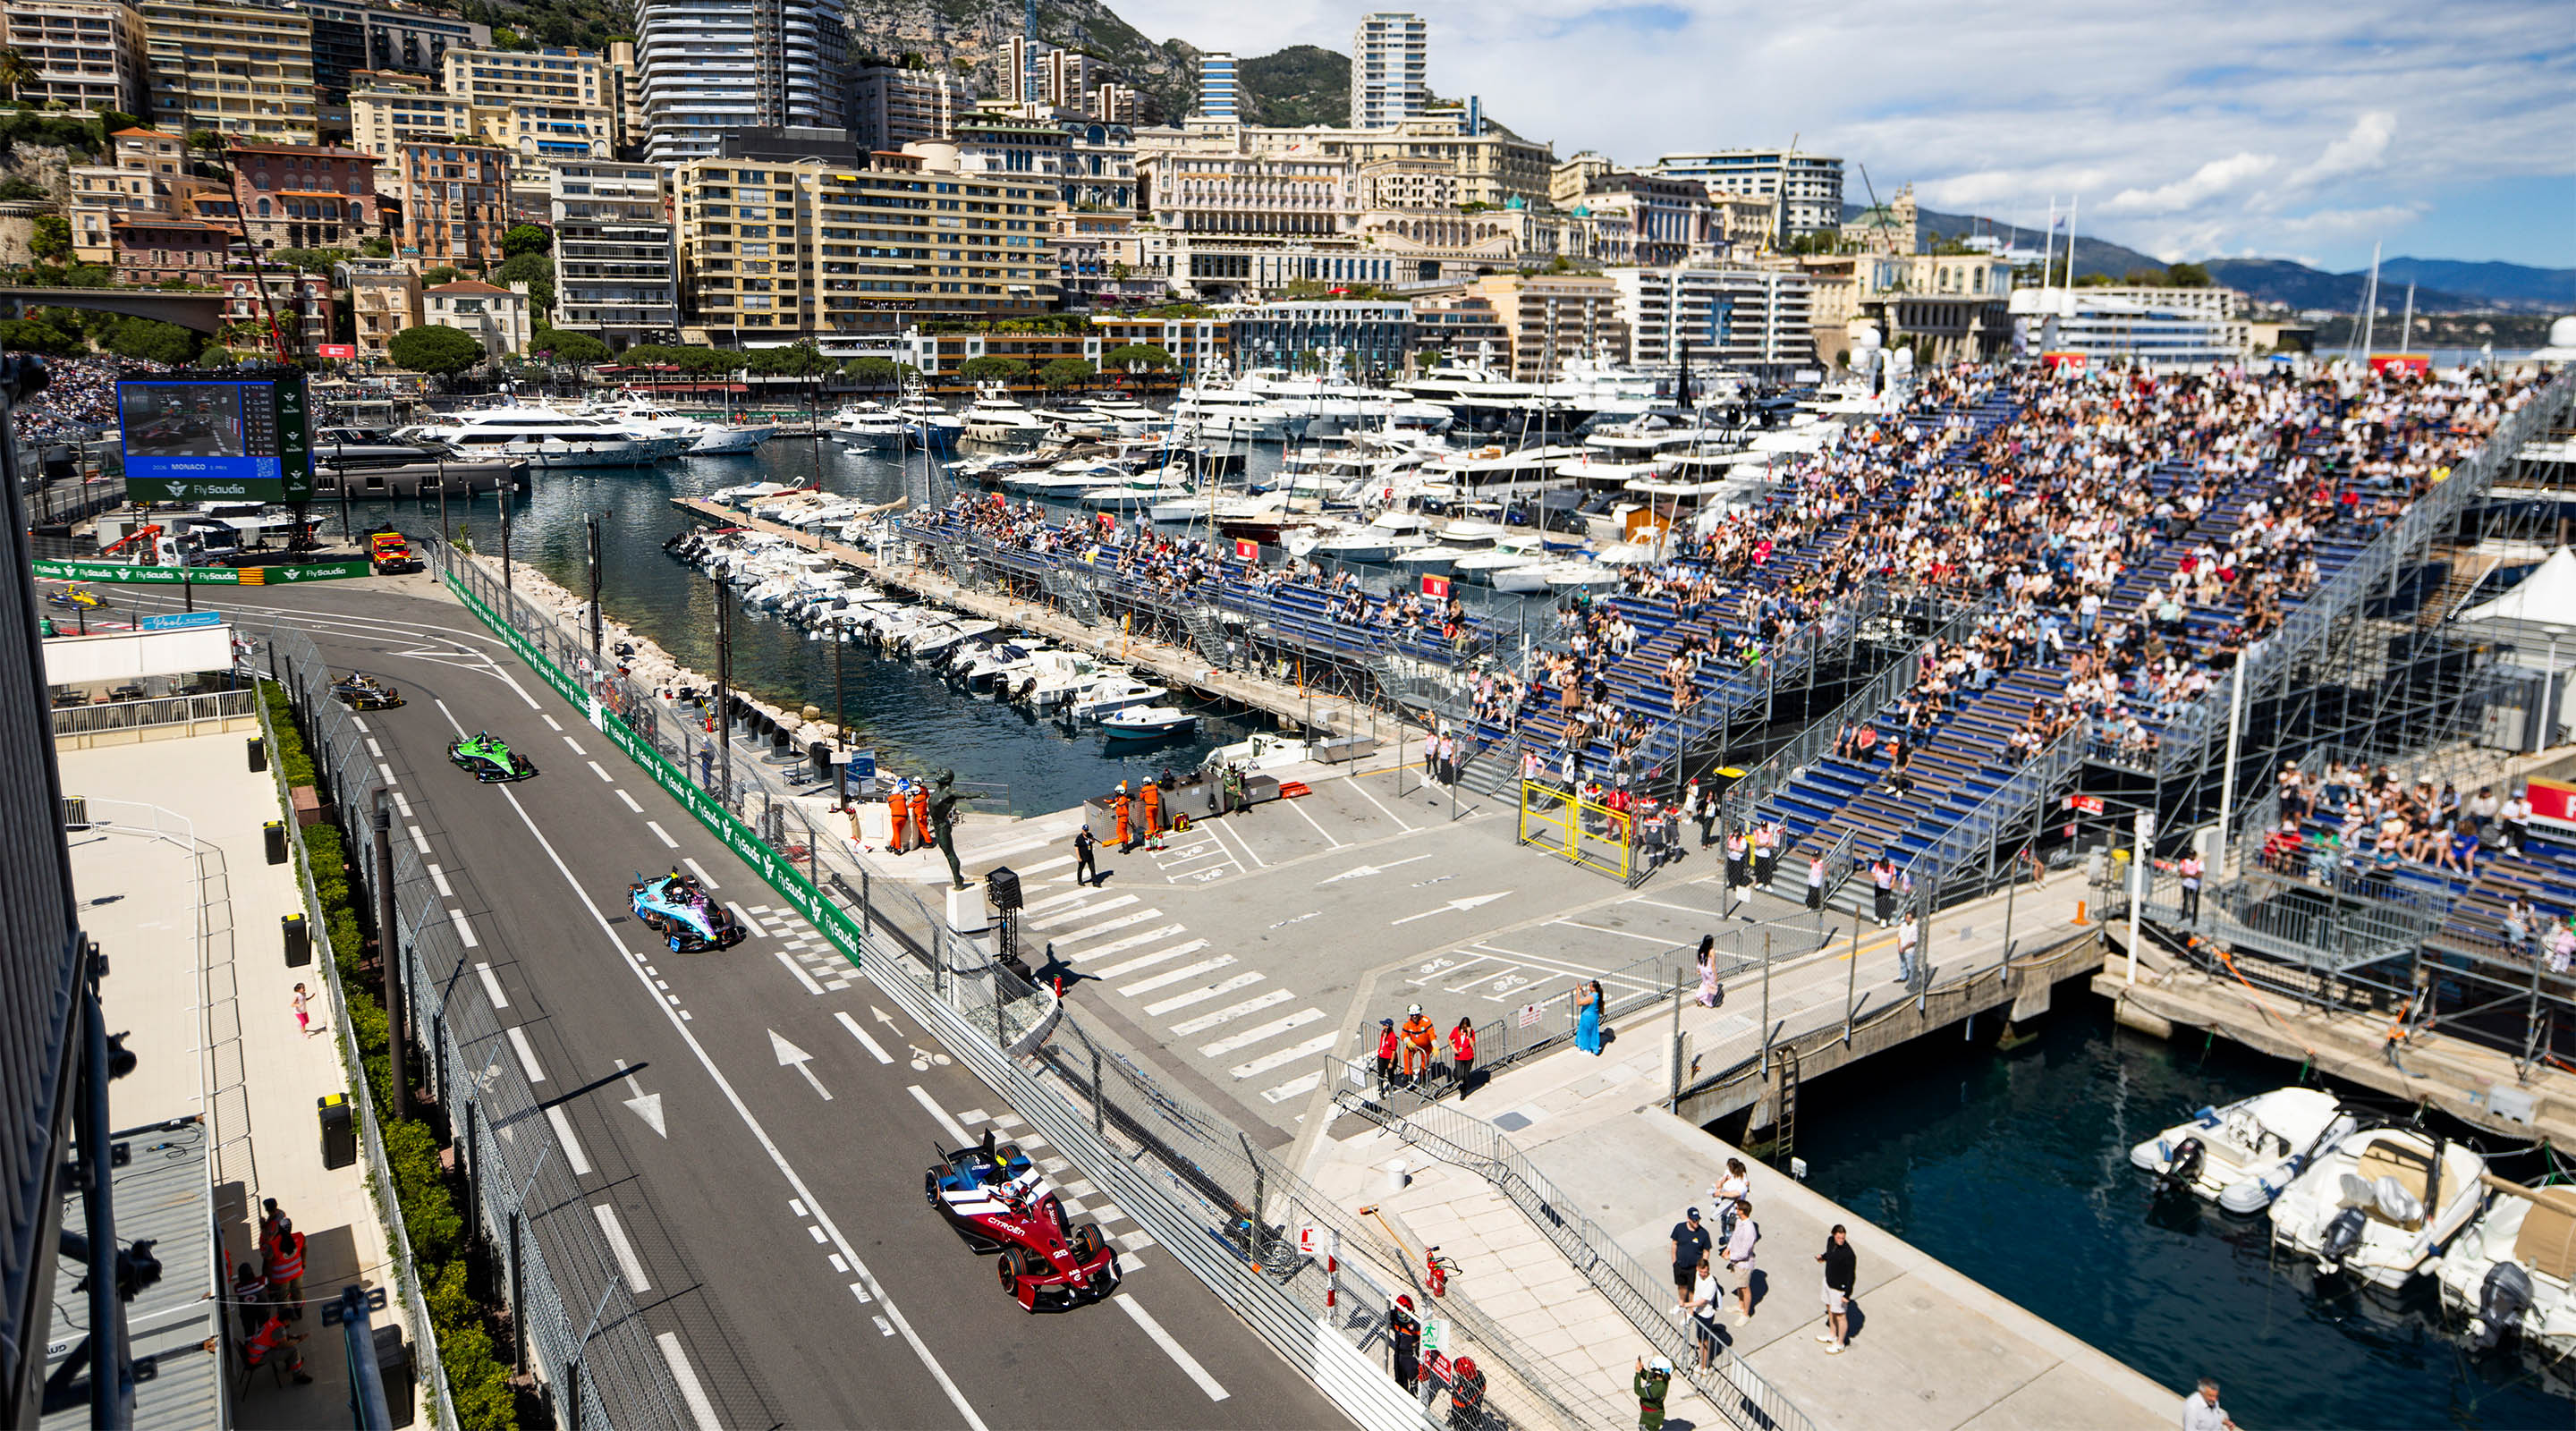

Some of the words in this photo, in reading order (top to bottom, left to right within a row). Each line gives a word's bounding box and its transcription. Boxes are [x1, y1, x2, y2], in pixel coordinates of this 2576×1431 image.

[171, 462, 206, 470] MONACO
[1434, 581, 1441, 595] N
[777, 869, 806, 907] FlySaudia
[826, 913, 858, 956] FlySaudia
